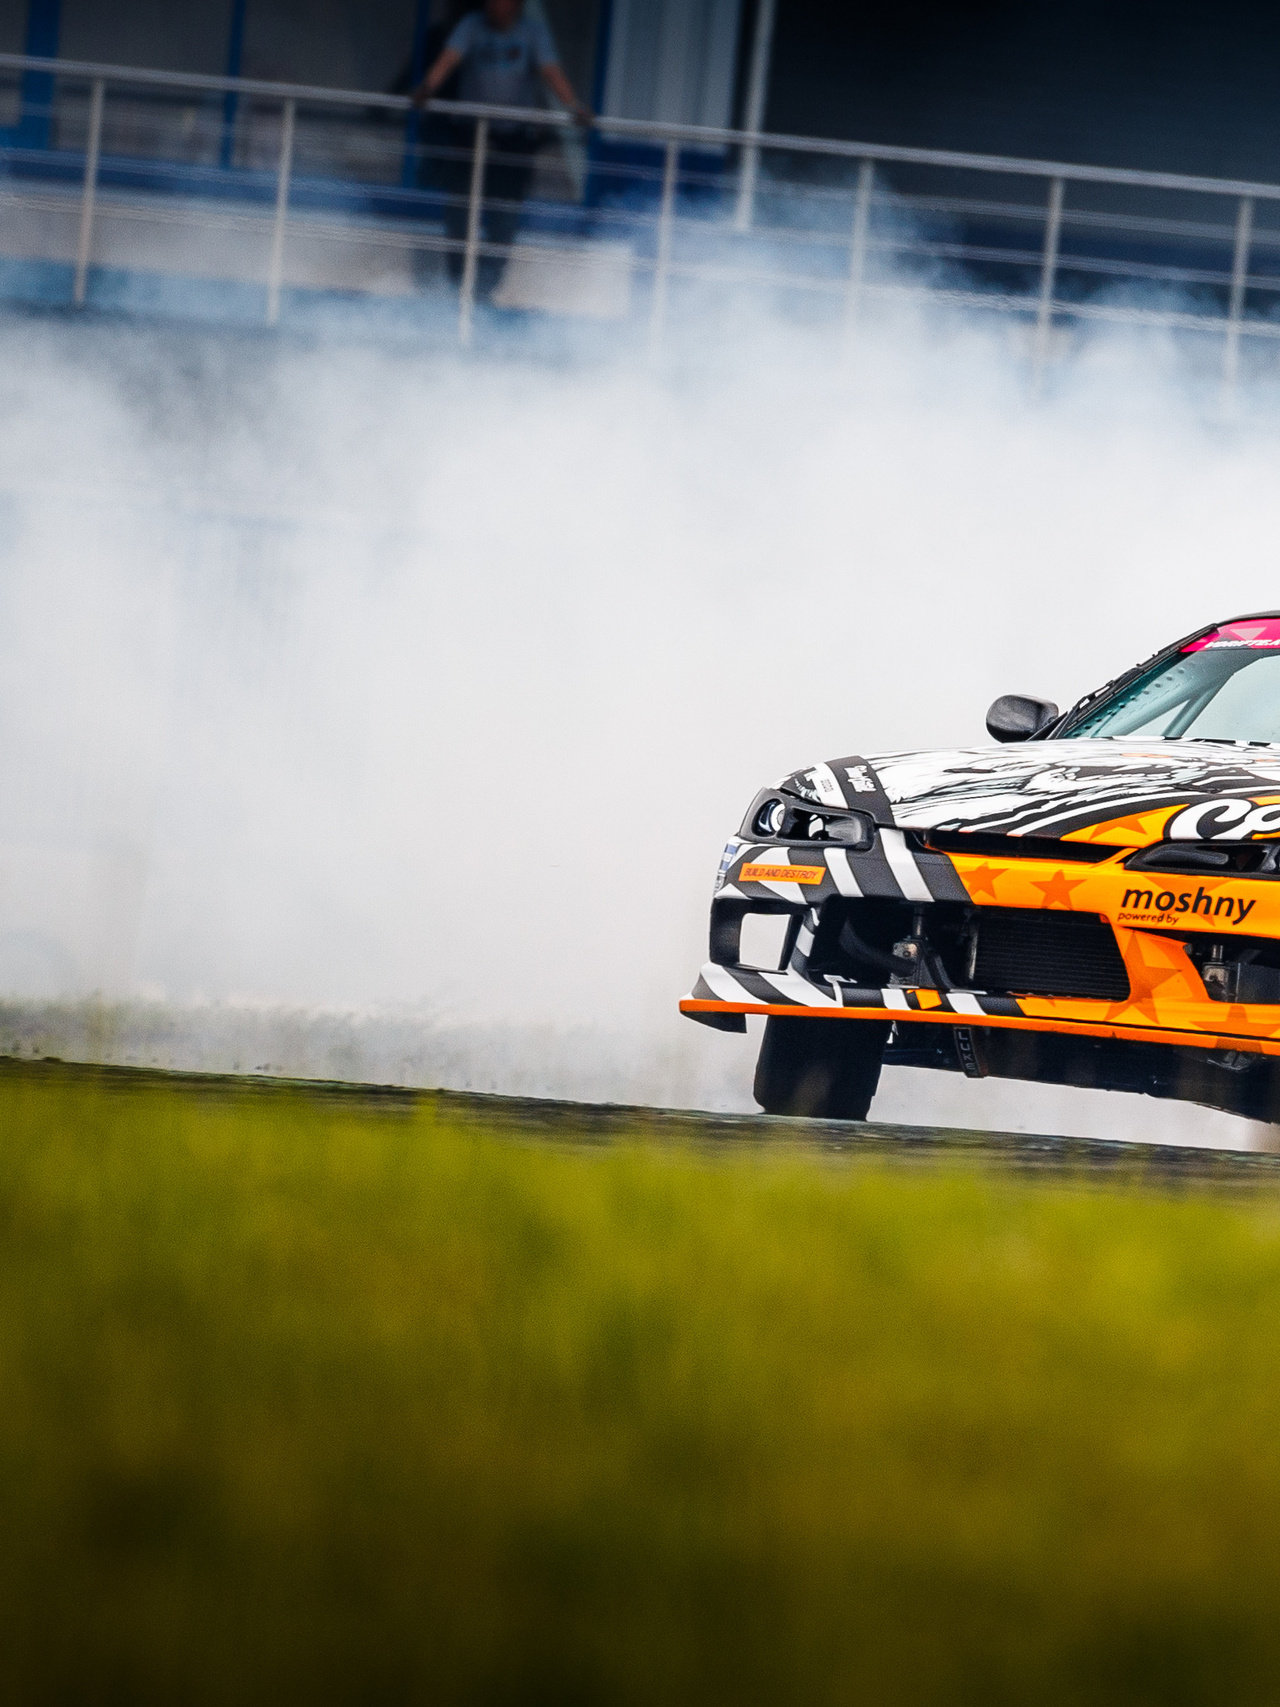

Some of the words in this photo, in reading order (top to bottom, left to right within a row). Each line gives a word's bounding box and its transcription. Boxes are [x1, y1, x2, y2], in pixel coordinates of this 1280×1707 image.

[744, 867, 764, 877] BUILD
[765, 868, 780, 877] AND
[780, 869, 819, 879] DESTROY
[1121, 887, 1257, 925] moshny
[1117, 912, 1164, 922] powered
[1166, 914, 1180, 925] by
